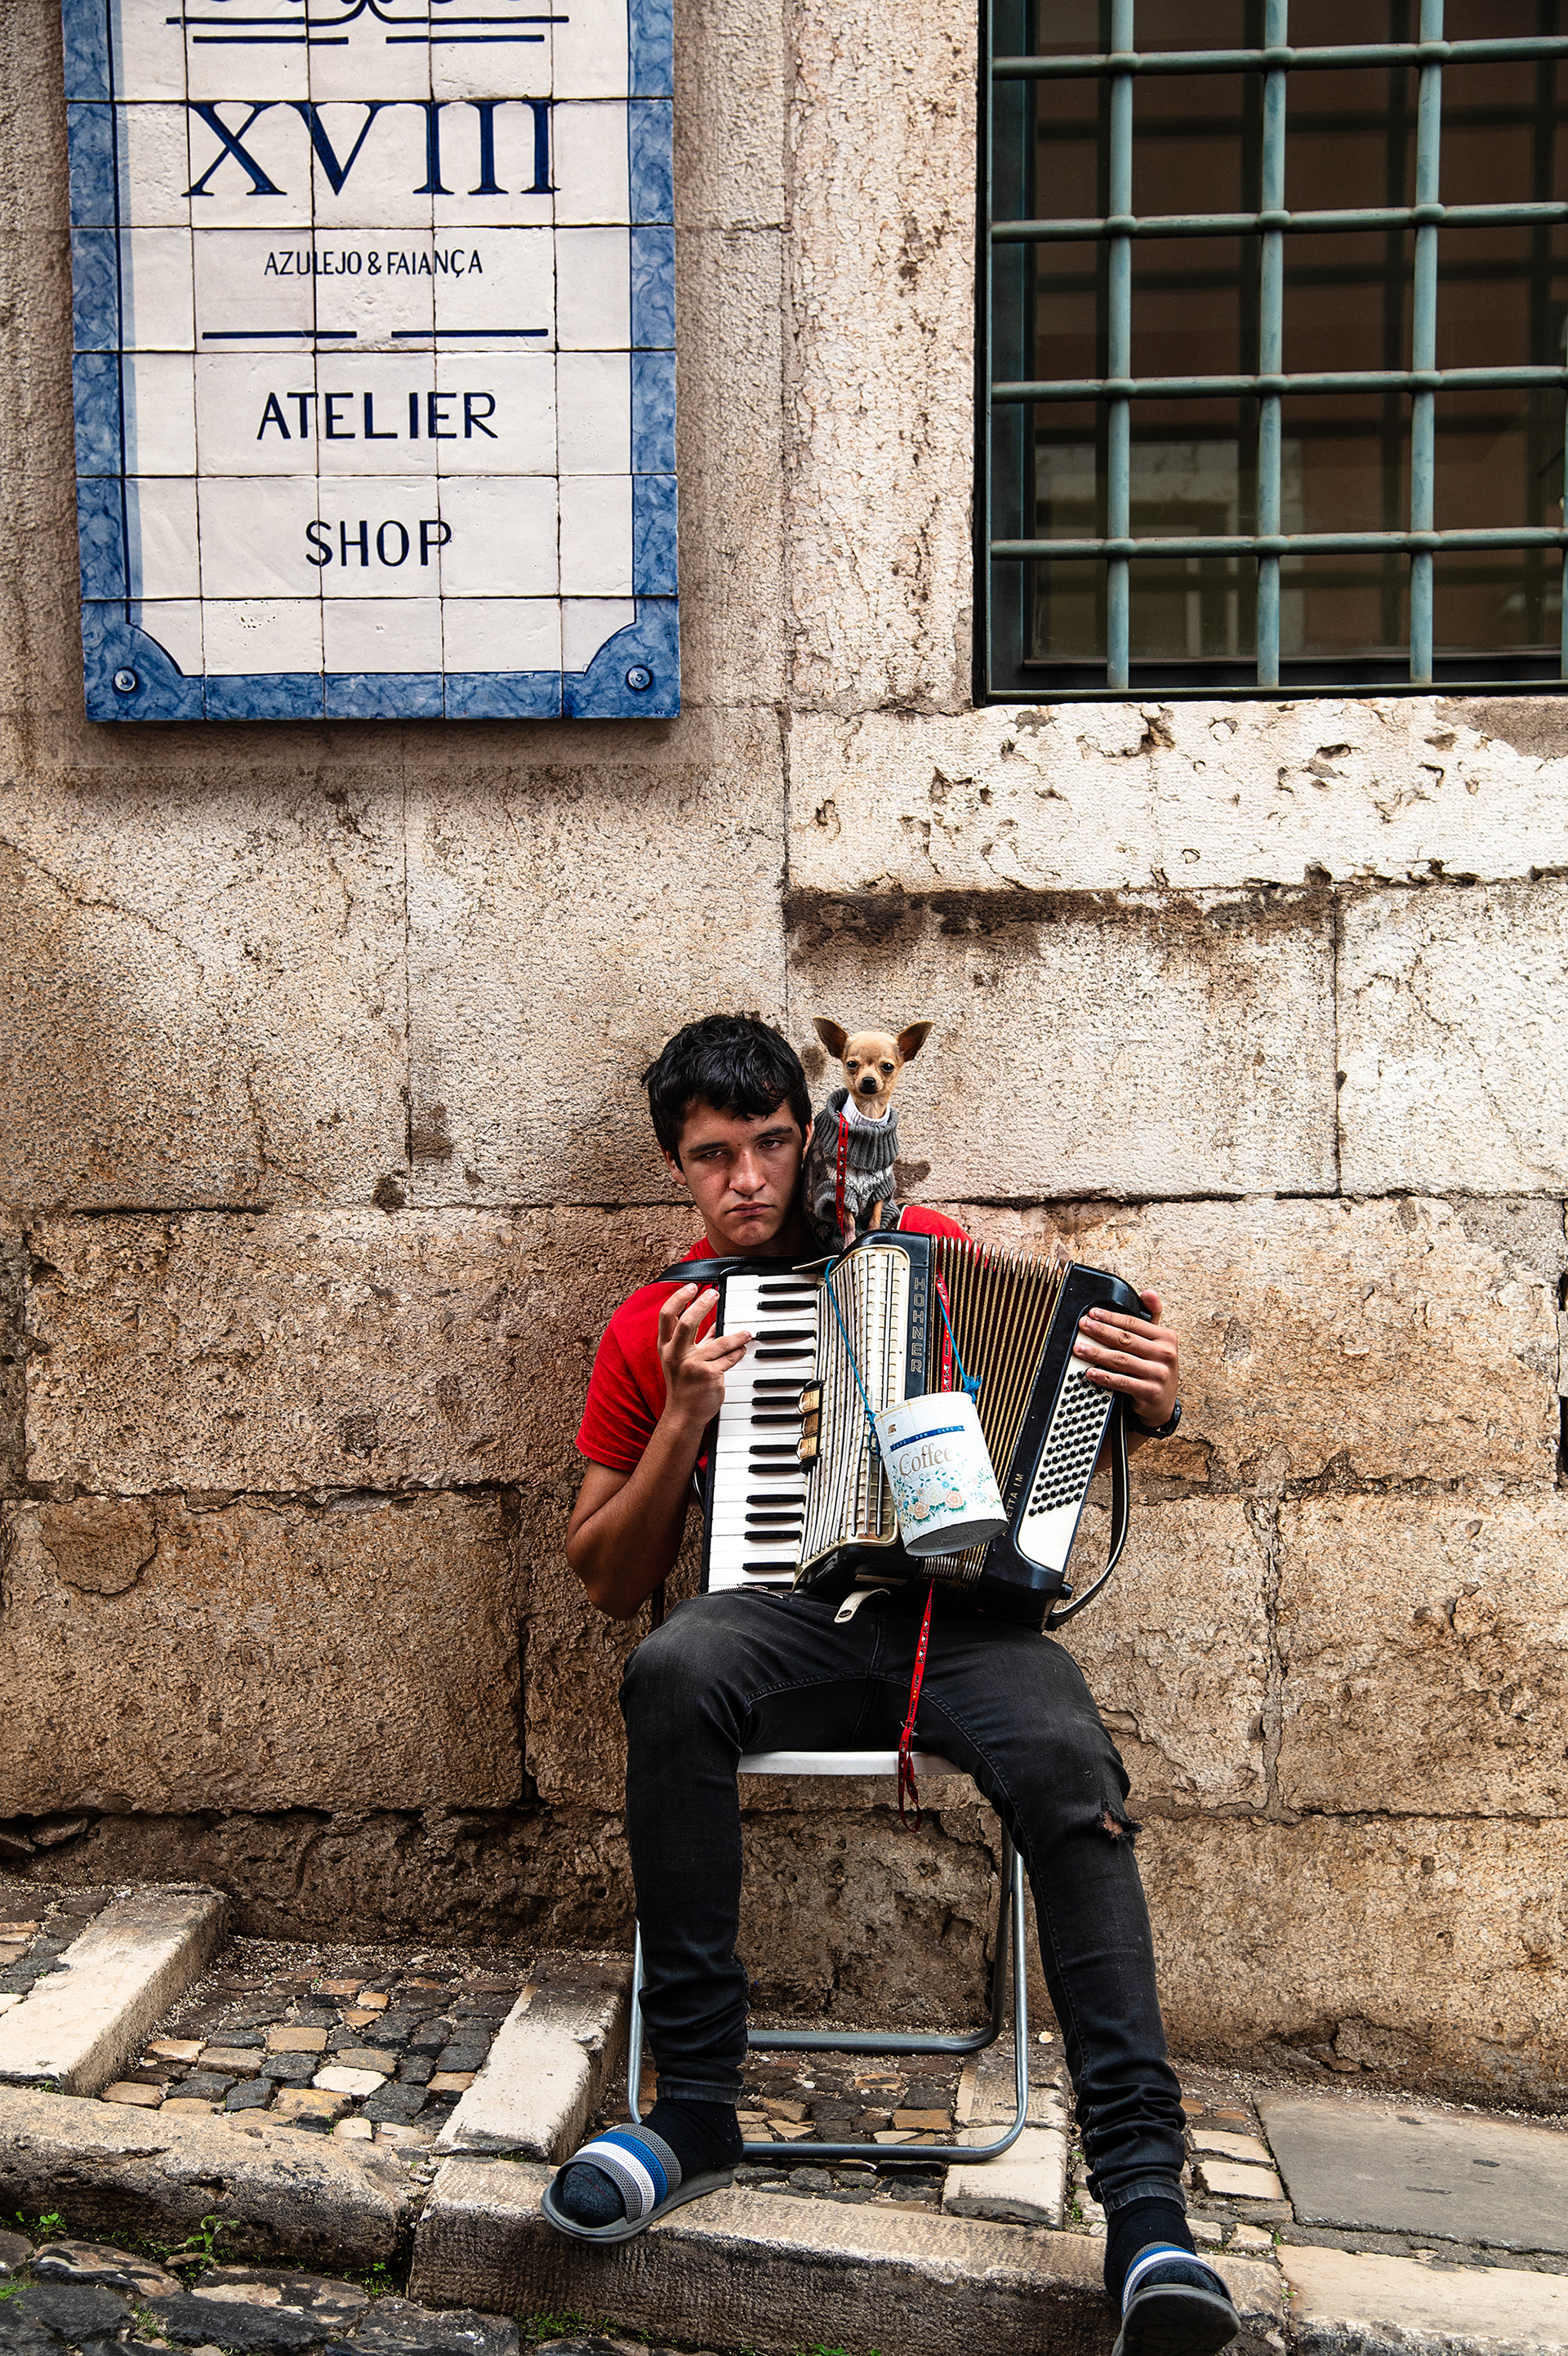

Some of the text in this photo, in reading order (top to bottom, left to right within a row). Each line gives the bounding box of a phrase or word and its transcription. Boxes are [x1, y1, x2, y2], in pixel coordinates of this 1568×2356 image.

[181, 100, 561, 196] XVIII
[264, 249, 483, 278] AZULEJO & FAIANÇA
[256, 391, 498, 440] ATELIER
[305, 519, 452, 568] SHOP
[911, 1276, 926, 1374] HOHNER
[899, 1442, 953, 1476] Coffee
